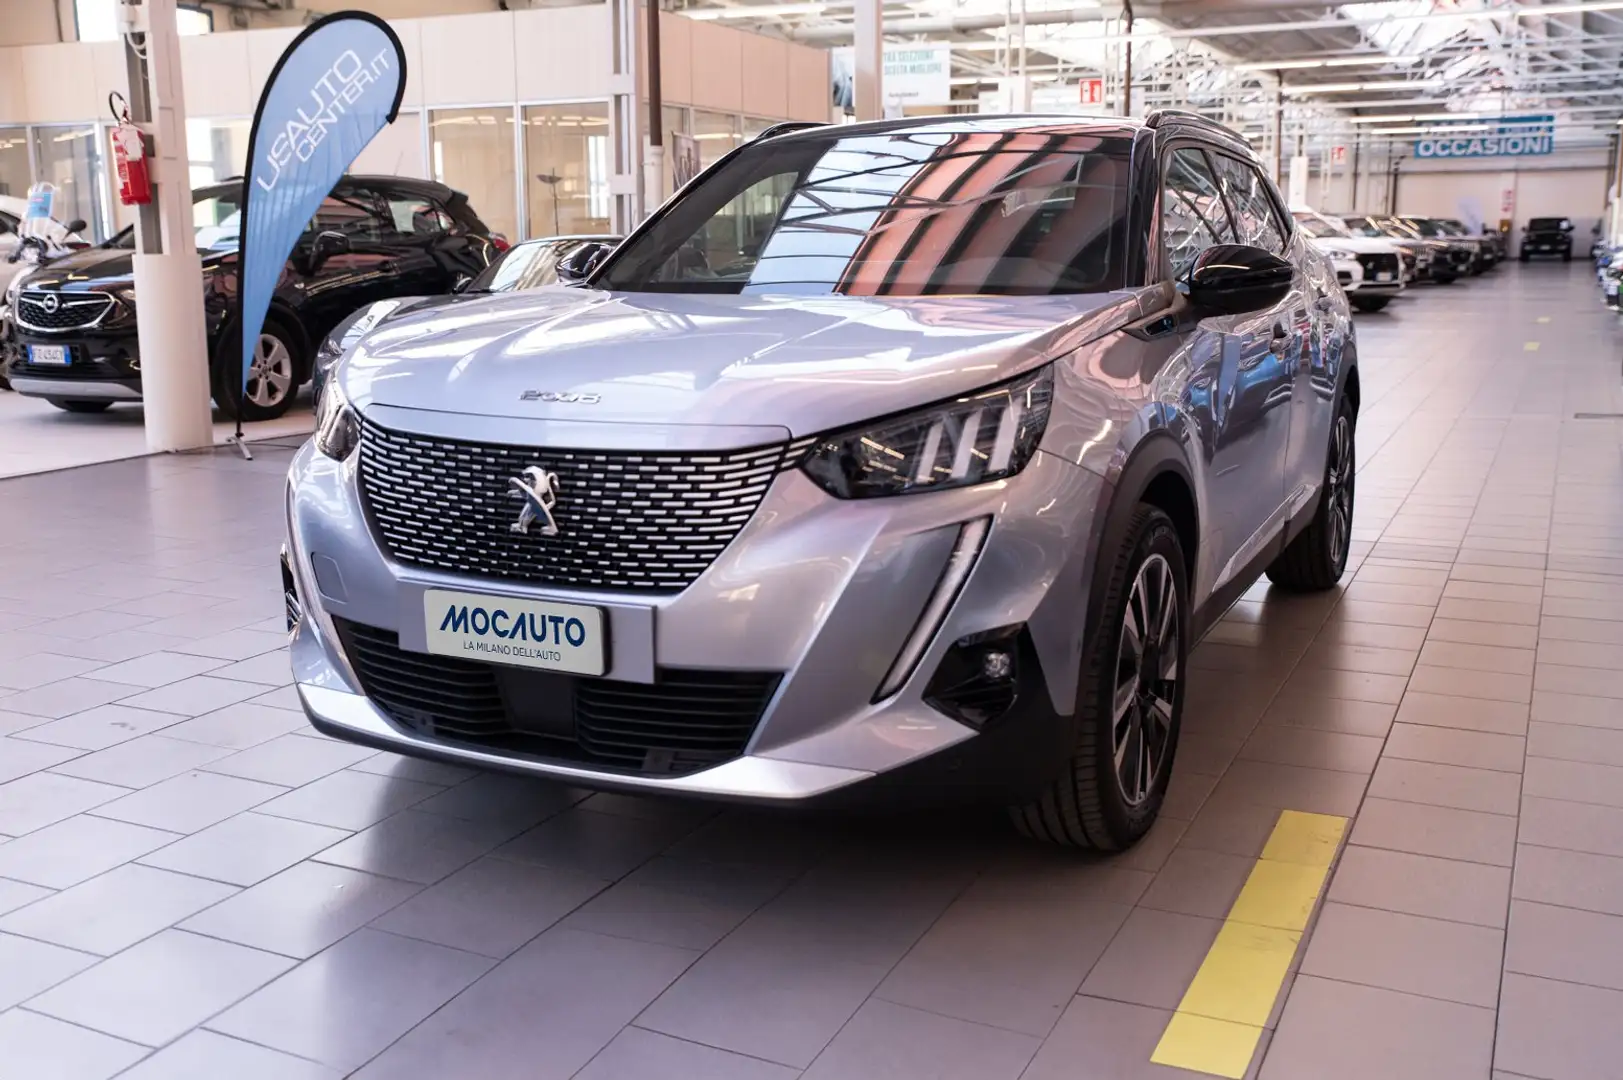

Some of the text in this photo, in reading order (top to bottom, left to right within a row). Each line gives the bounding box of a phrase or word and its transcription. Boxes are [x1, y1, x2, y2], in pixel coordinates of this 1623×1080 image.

[256, 49, 362, 192] USAUTO
[295, 47, 390, 163] CENTER.IT
[1418, 136, 1550, 157] OCCASIONI
[439, 604, 586, 648] MOCAUTO
[463, 640, 562, 662] LA MILANO DELL'AUTO
